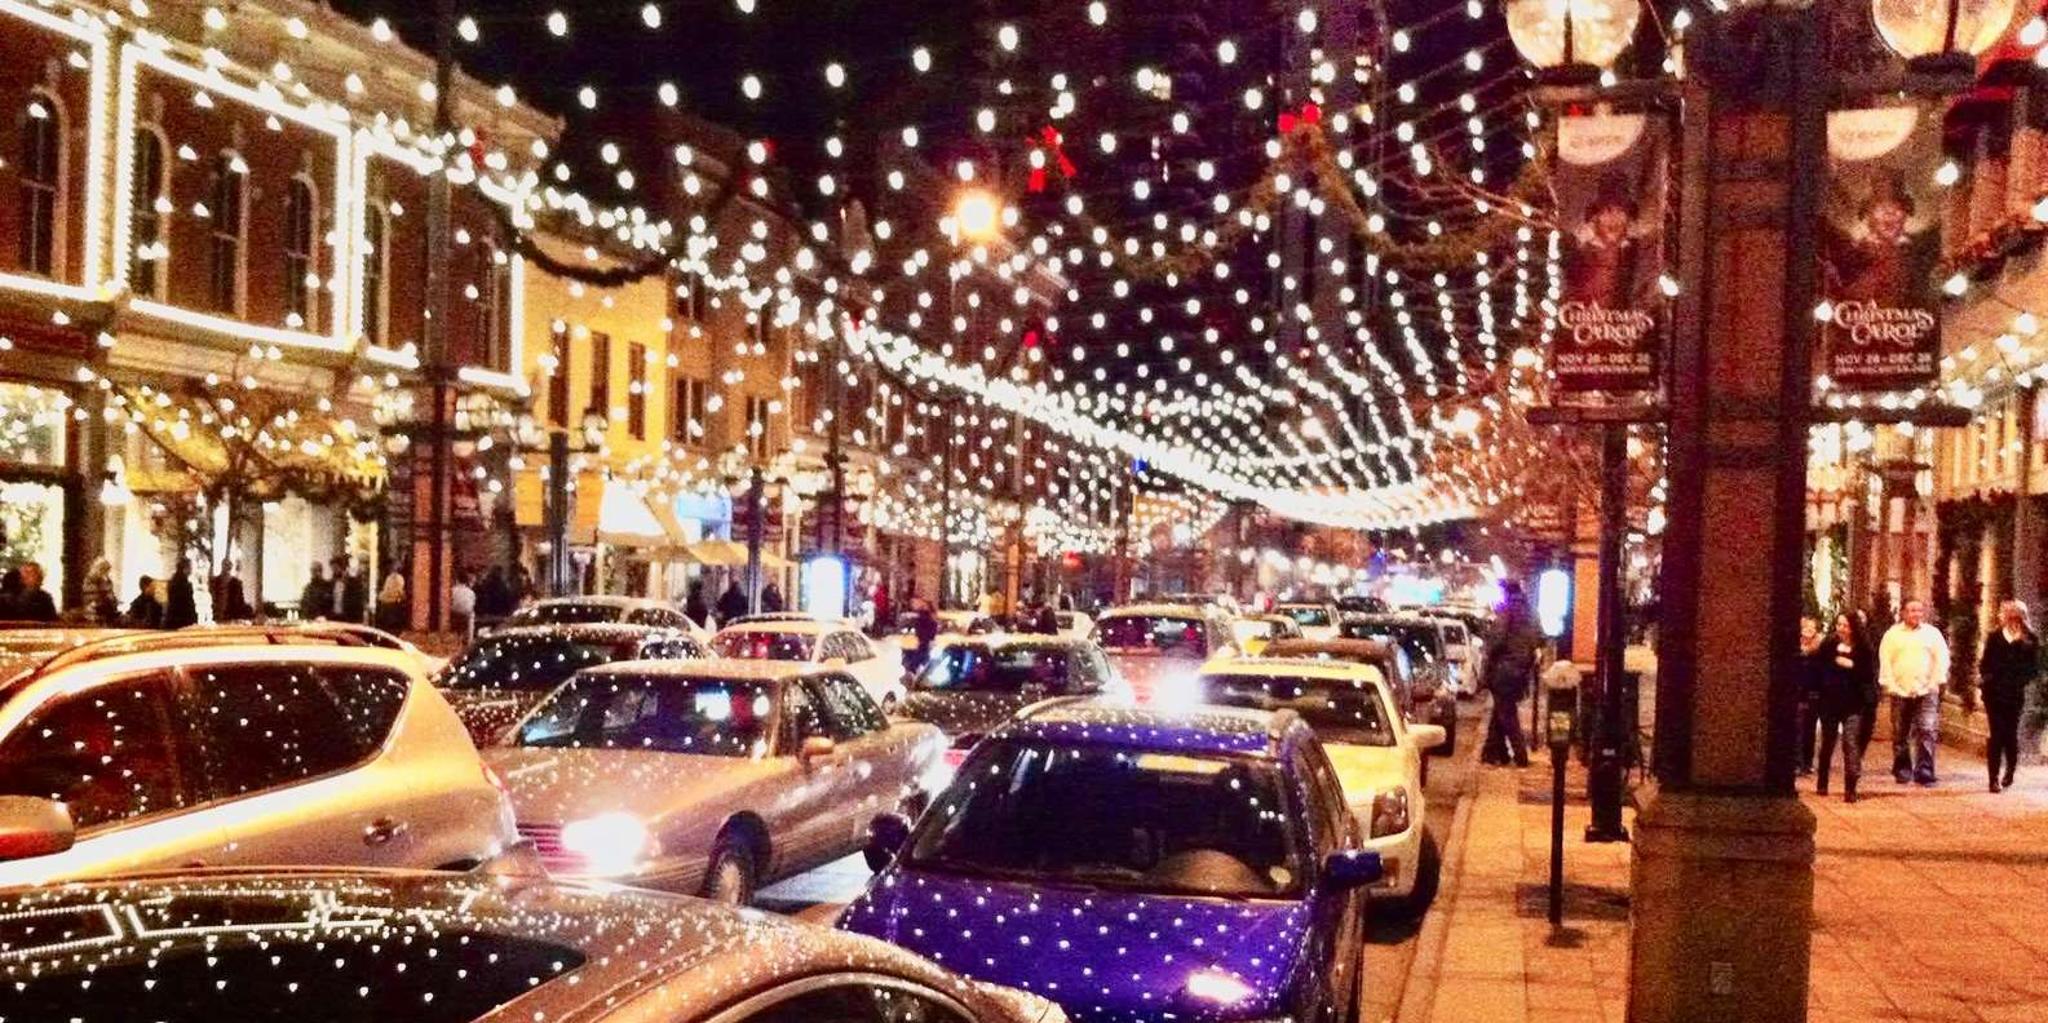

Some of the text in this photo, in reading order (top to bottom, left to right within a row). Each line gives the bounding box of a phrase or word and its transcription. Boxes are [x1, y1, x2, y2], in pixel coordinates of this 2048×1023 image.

[1558, 301, 1654, 332] CHRISTMAS
[1834, 301, 1934, 331] CHRISTMAS
[1573, 322, 1640, 347] CAROL
[1851, 322, 1922, 347] CAROL
[1558, 354, 1583, 364] NOV
[1835, 354, 1861, 364] NOV
[1889, 353, 1914, 363] DEC
